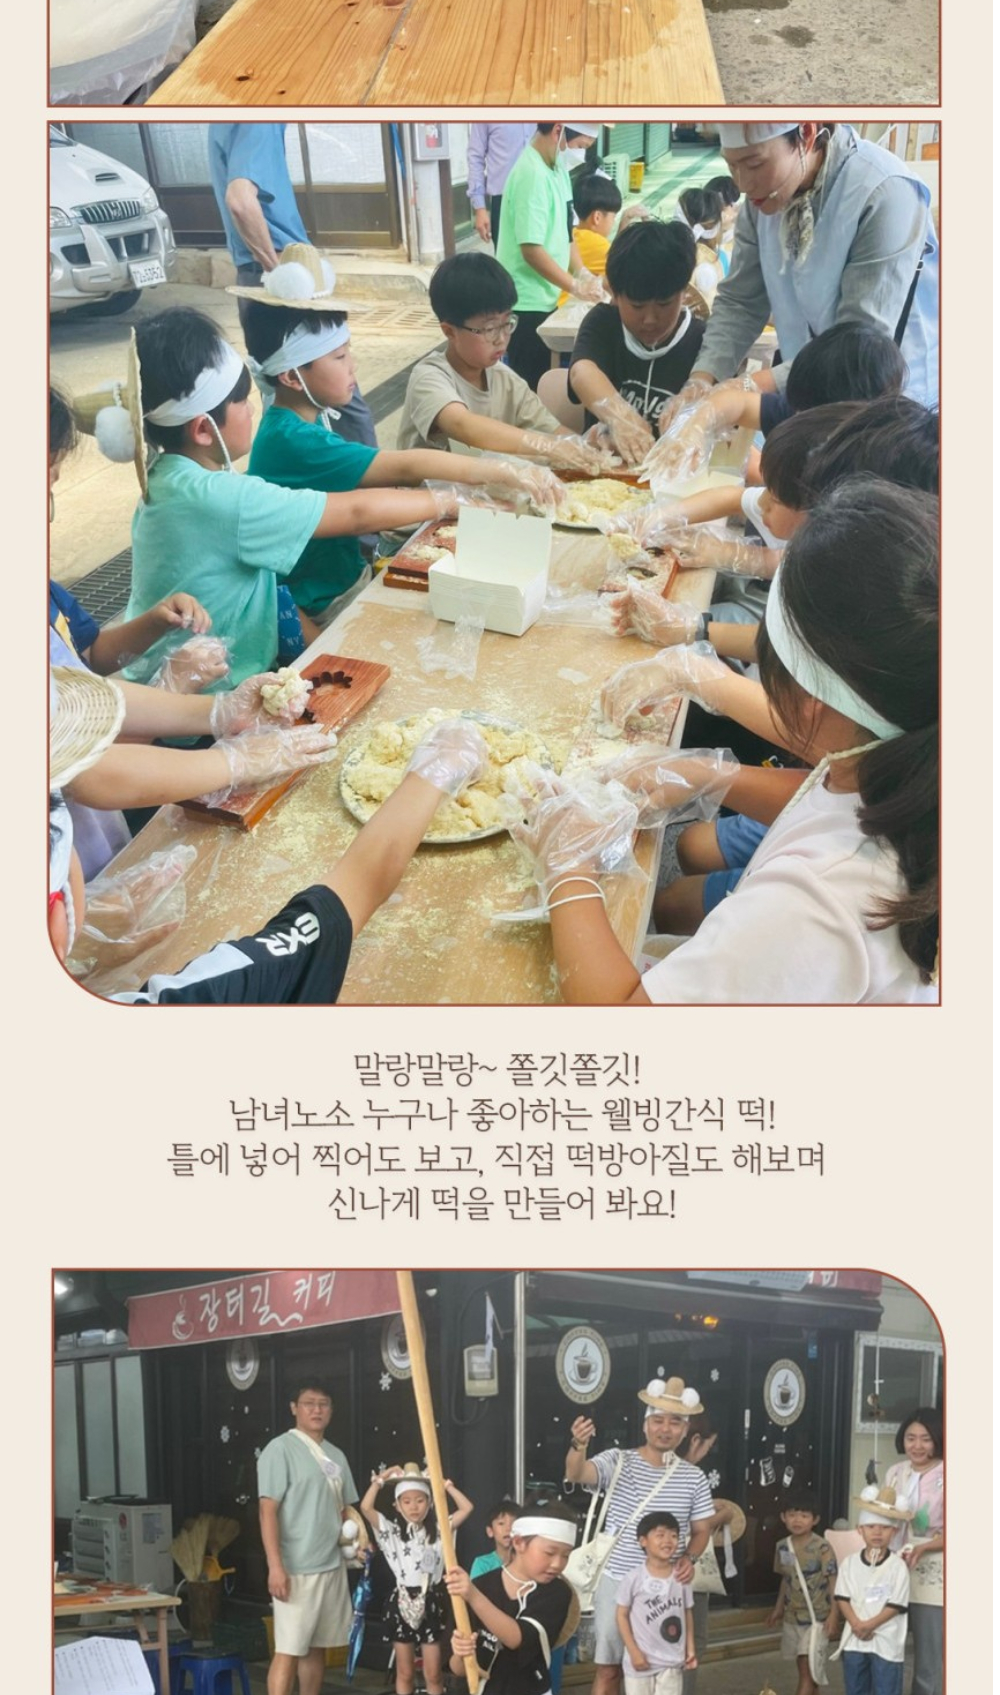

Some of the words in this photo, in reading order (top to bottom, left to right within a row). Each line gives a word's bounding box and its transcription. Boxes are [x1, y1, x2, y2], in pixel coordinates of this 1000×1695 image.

[255, 911, 321, 957] EXR
[199, 1277, 304, 1333] 장터길
[293, 1270, 336, 1311] 커피
